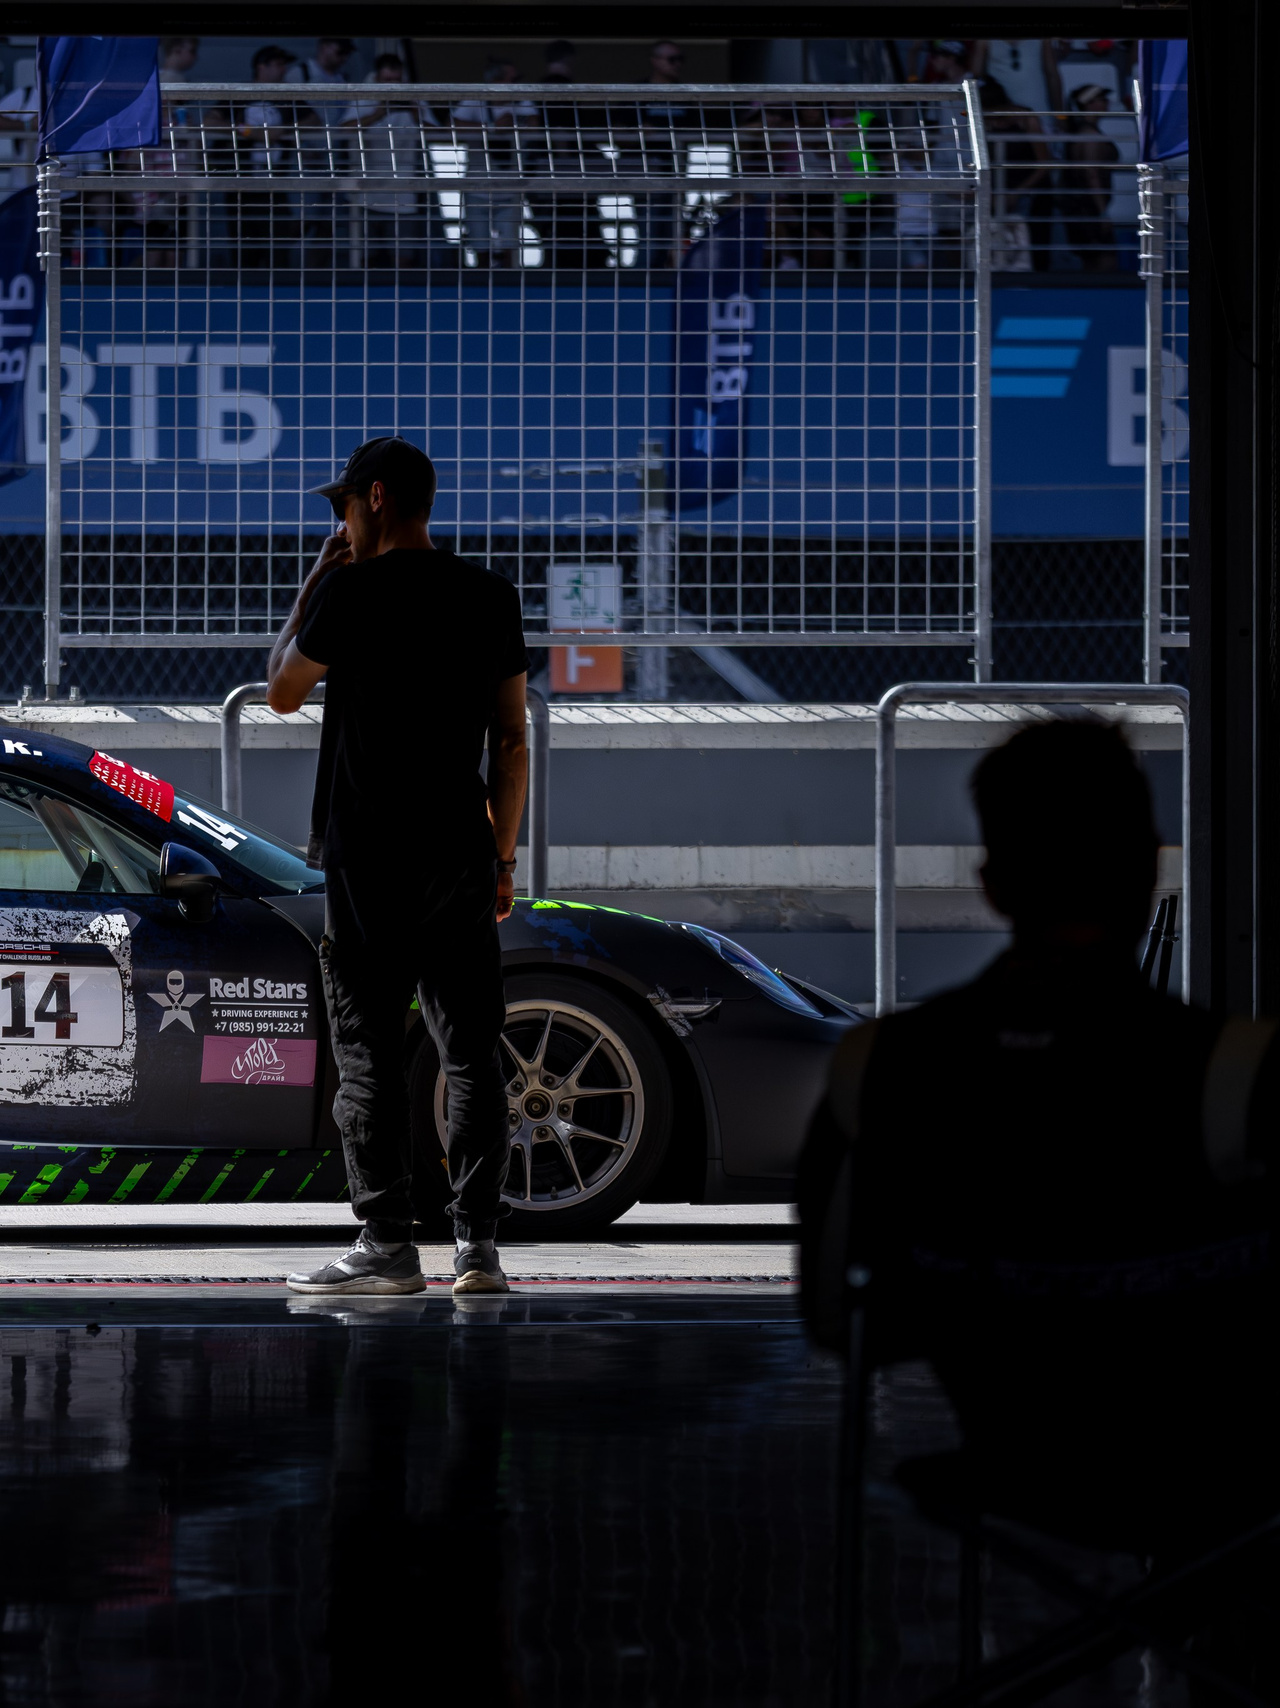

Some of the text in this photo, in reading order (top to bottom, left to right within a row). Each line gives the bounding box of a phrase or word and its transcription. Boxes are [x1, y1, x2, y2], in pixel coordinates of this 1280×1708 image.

[706, 292, 756, 403] ВТБ
[24, 343, 283, 464] ВТБ
[176, 804, 248, 851] 14
[2, 953, 28, 961] CHALLENGE
[2, 971, 78, 1039] 14
[209, 977, 308, 1000] Red Stars
[214, 1021, 305, 1034] +7 (985) 991-22-21
[221, 1009, 299, 1019] DRIVING EXPERIENCE
